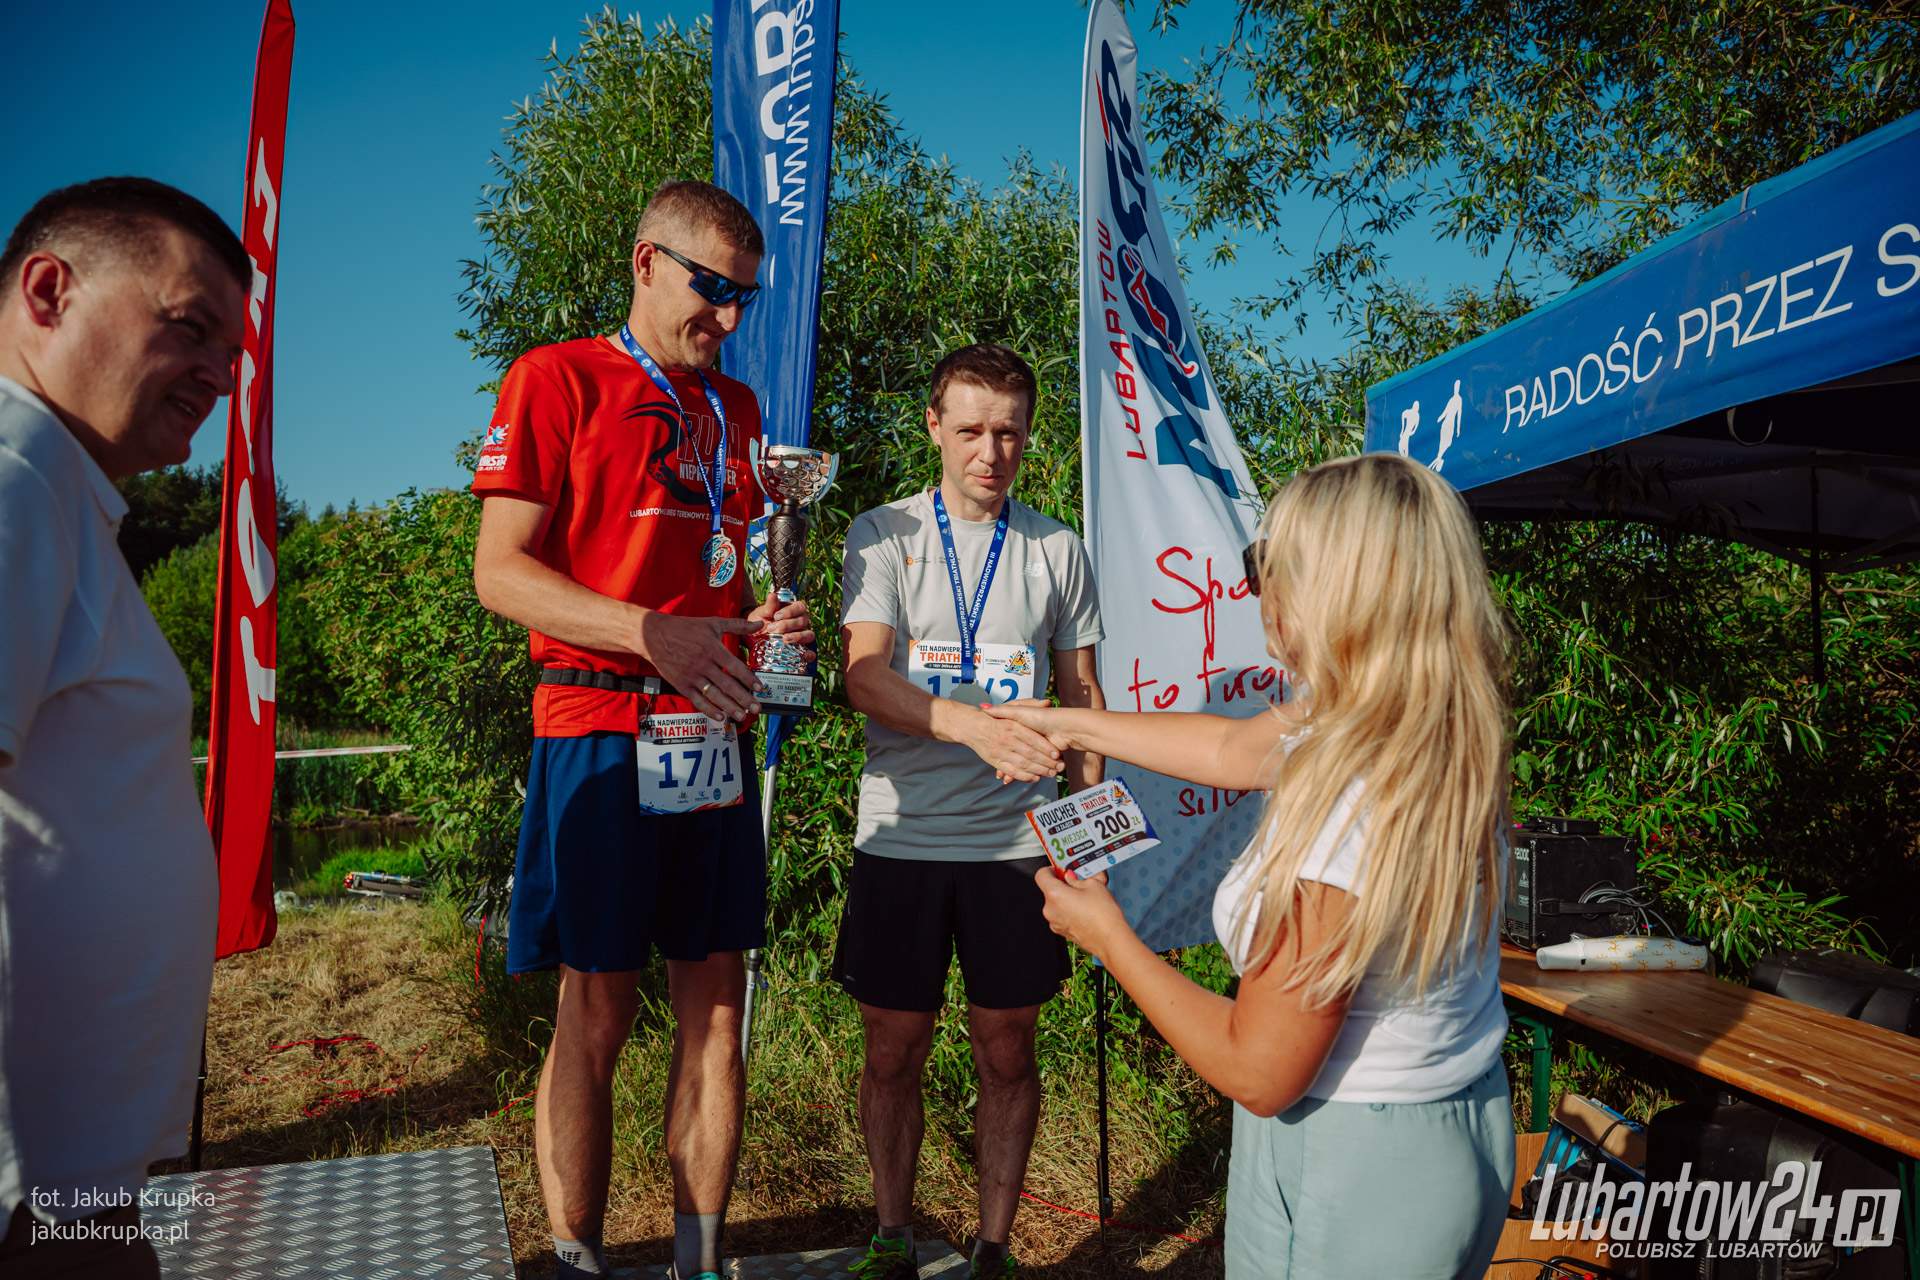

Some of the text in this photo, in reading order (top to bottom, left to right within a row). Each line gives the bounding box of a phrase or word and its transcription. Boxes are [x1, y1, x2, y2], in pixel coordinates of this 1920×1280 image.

[1096, 217, 1147, 460] LUBARTÓW
[1502, 312, 1663, 434] RADOŚĆ
[1674, 245, 1854, 370] PRZEZ
[920, 652, 982, 663] TRIATHN
[649, 725, 708, 738] TRIATHLON
[659, 747, 734, 789] 17/1
[1037, 802, 1078, 828] VOUCHER
[1094, 810, 1131, 840] 200
[1051, 838, 1065, 861] 3
